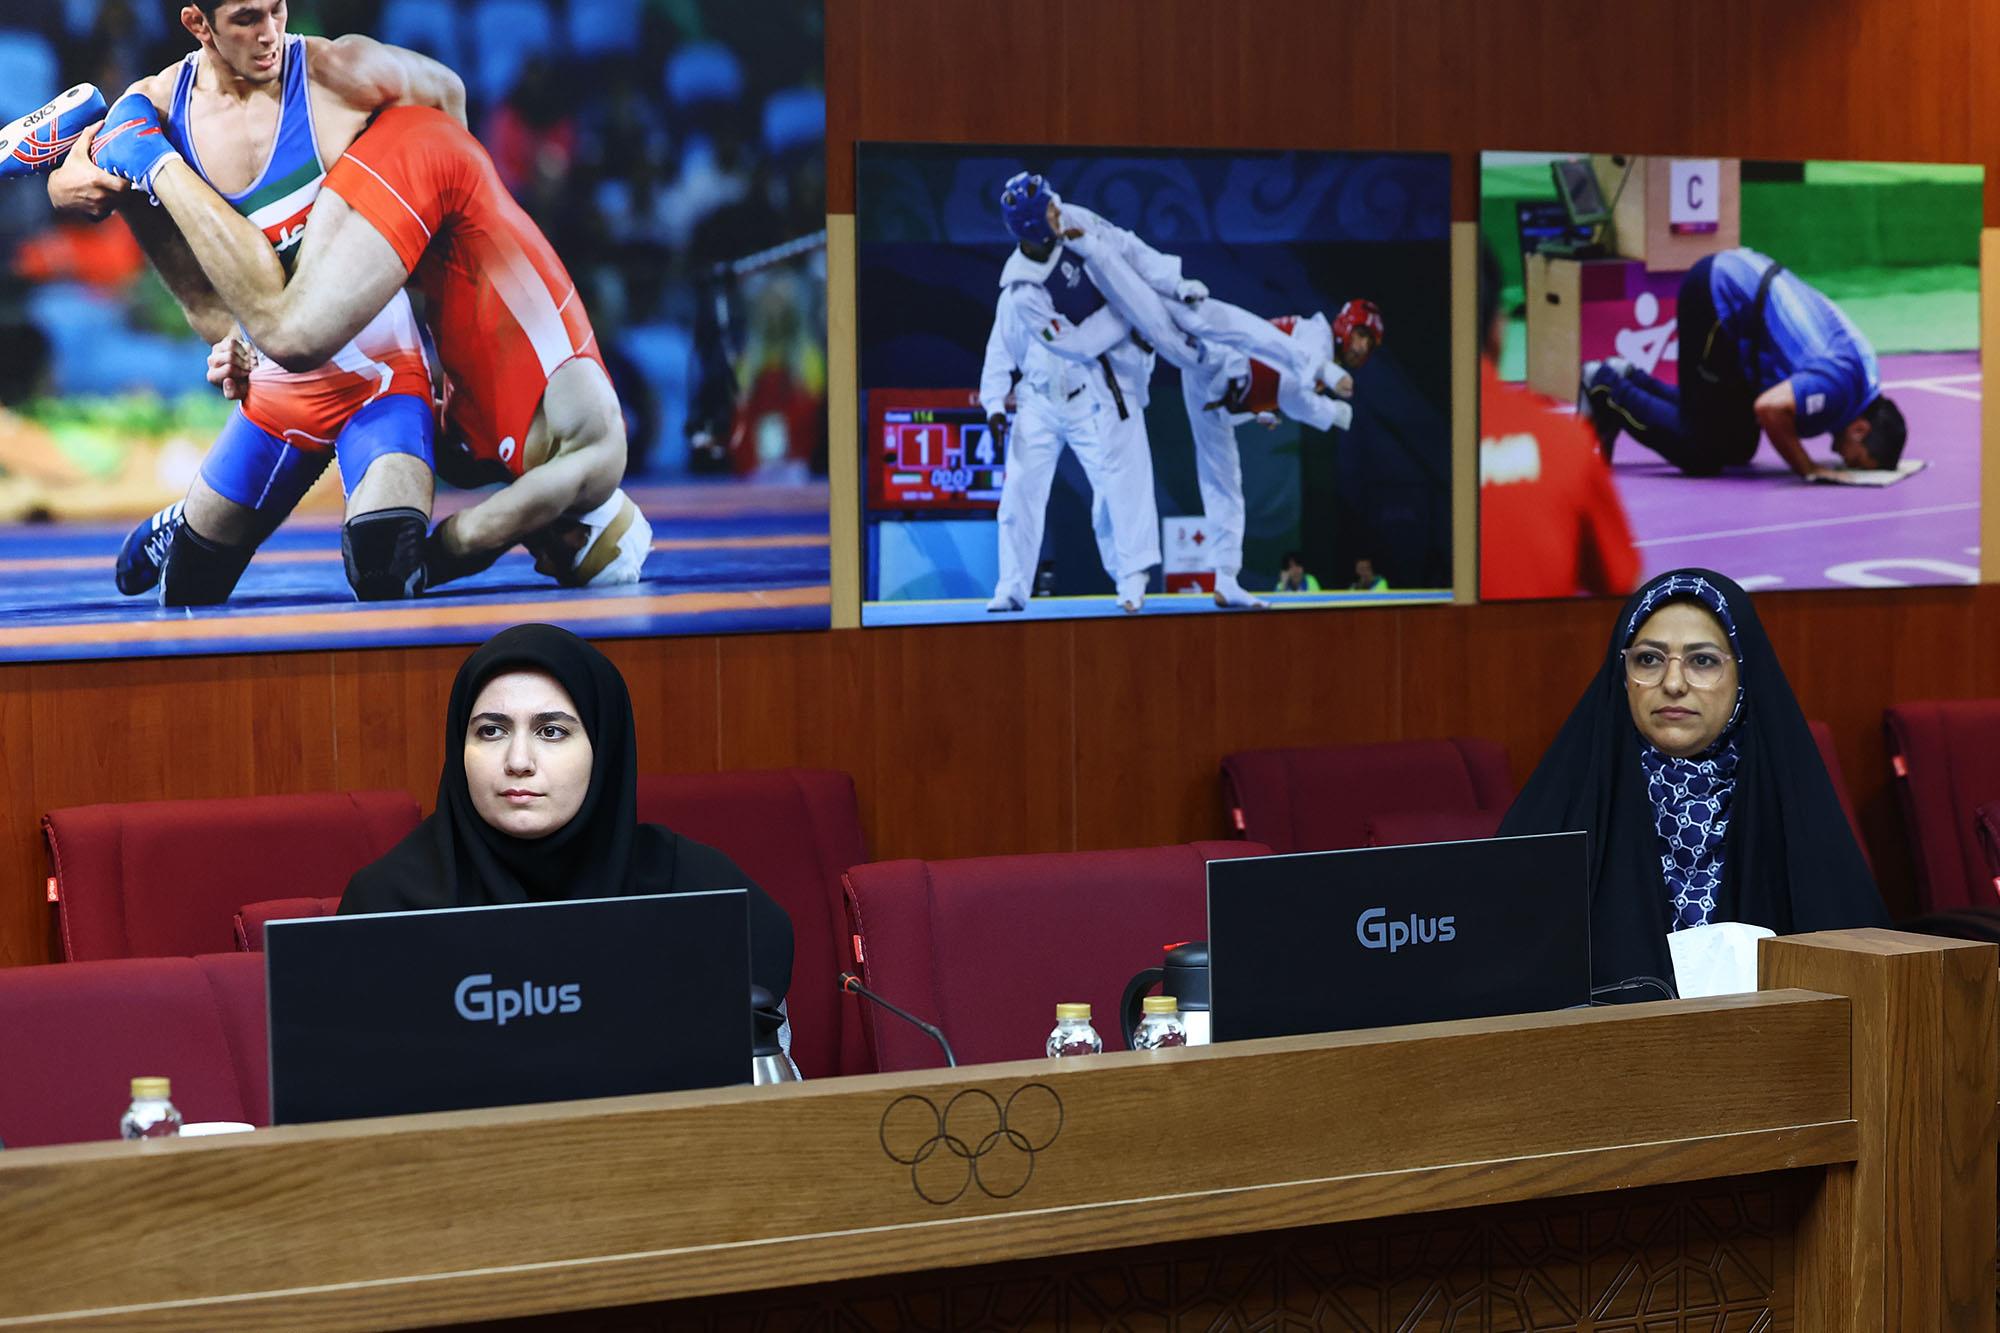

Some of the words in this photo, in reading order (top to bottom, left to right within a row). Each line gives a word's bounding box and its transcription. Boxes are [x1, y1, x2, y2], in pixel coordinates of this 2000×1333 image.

[1687, 174, 1704, 211] C
[915, 429, 929, 466] 1
[975, 430, 996, 465] 4
[1356, 907, 1457, 953] Gplus
[454, 973, 582, 1026] Gplus
